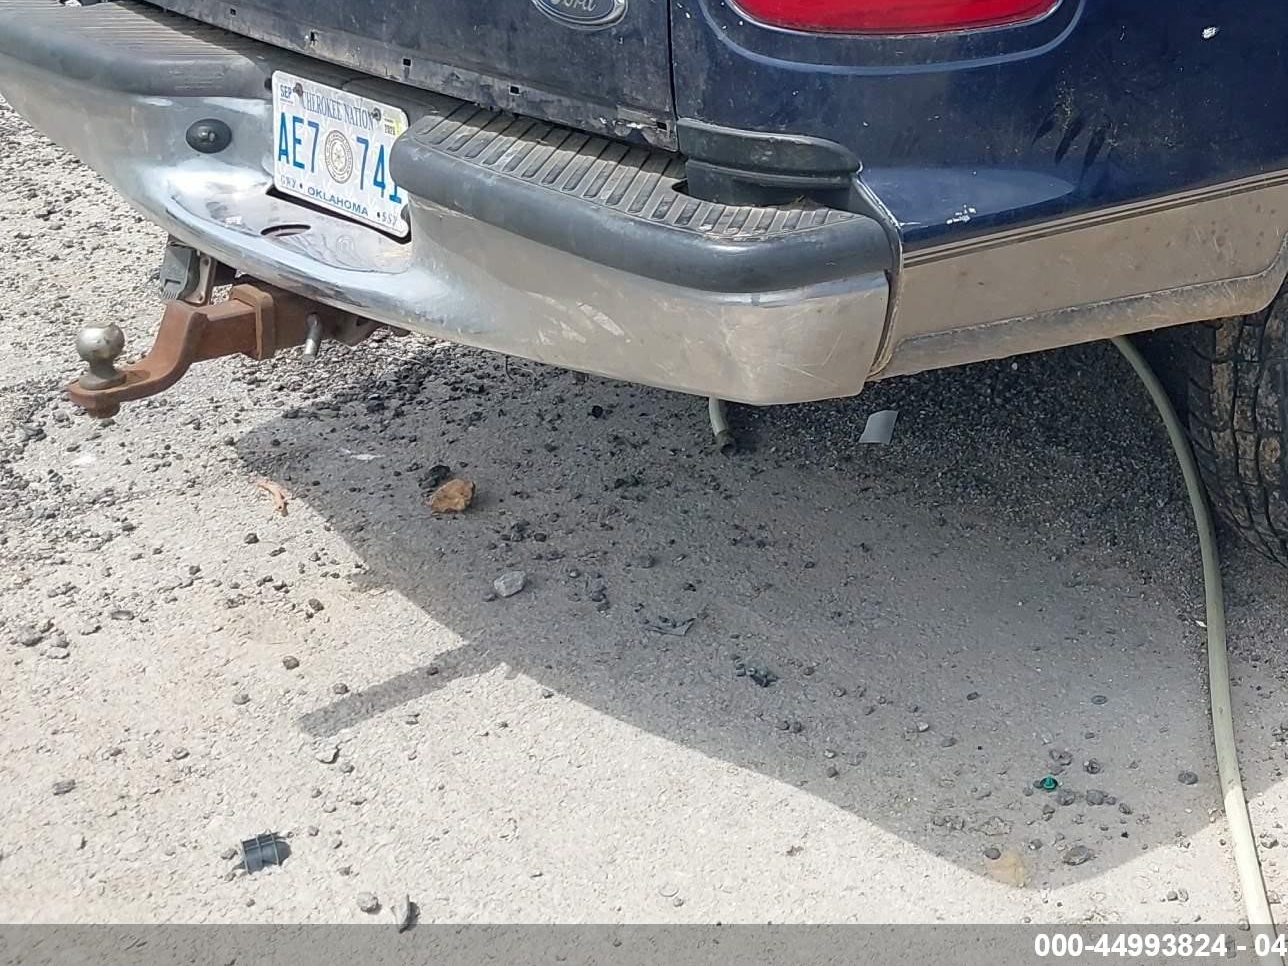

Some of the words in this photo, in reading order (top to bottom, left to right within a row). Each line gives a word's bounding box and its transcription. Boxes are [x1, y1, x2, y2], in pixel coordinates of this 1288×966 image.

[279, 84, 292, 99] SEP
[343, 104, 375, 131] NATION
[278, 111, 320, 174] AE7
[307, 186, 369, 217] OKLAHOMA
